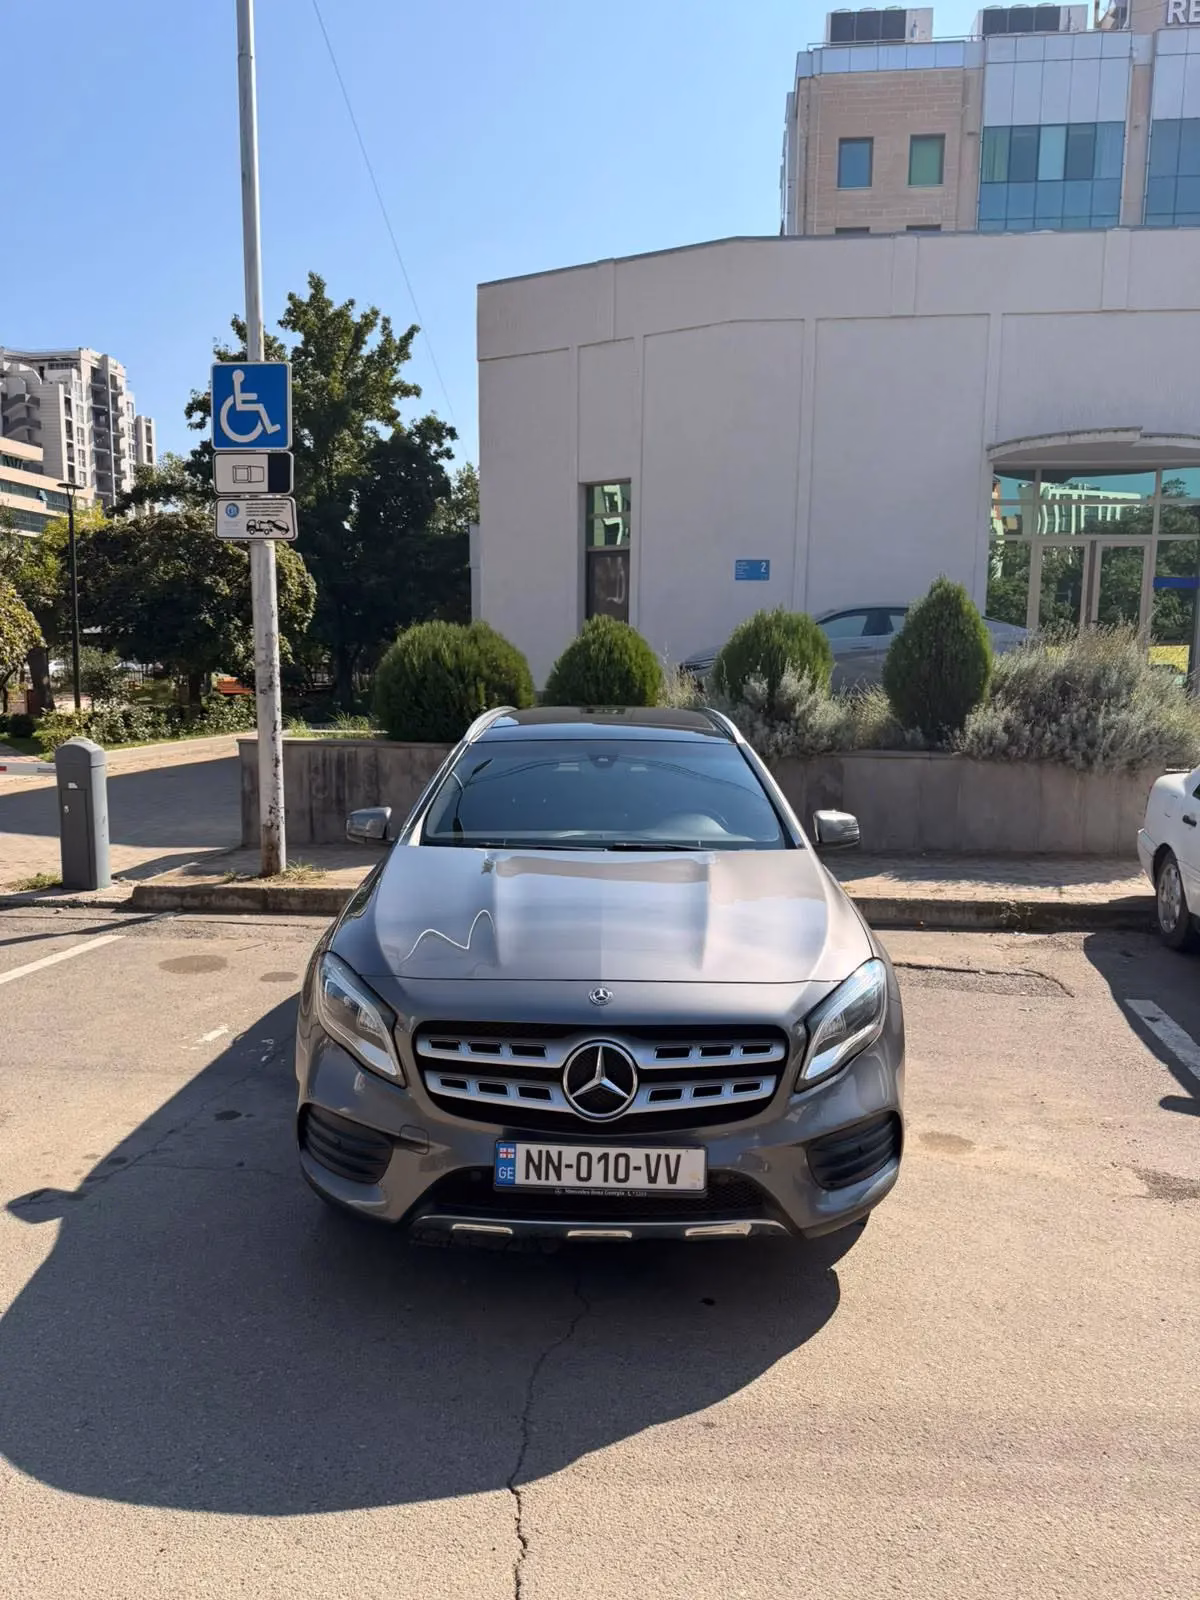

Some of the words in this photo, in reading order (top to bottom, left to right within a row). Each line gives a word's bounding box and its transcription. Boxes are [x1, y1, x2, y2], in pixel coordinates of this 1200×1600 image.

[761, 562, 767, 572] 2
[525, 1149, 681, 1184] NN-010-VV
[499, 1167, 514, 1179] GE
